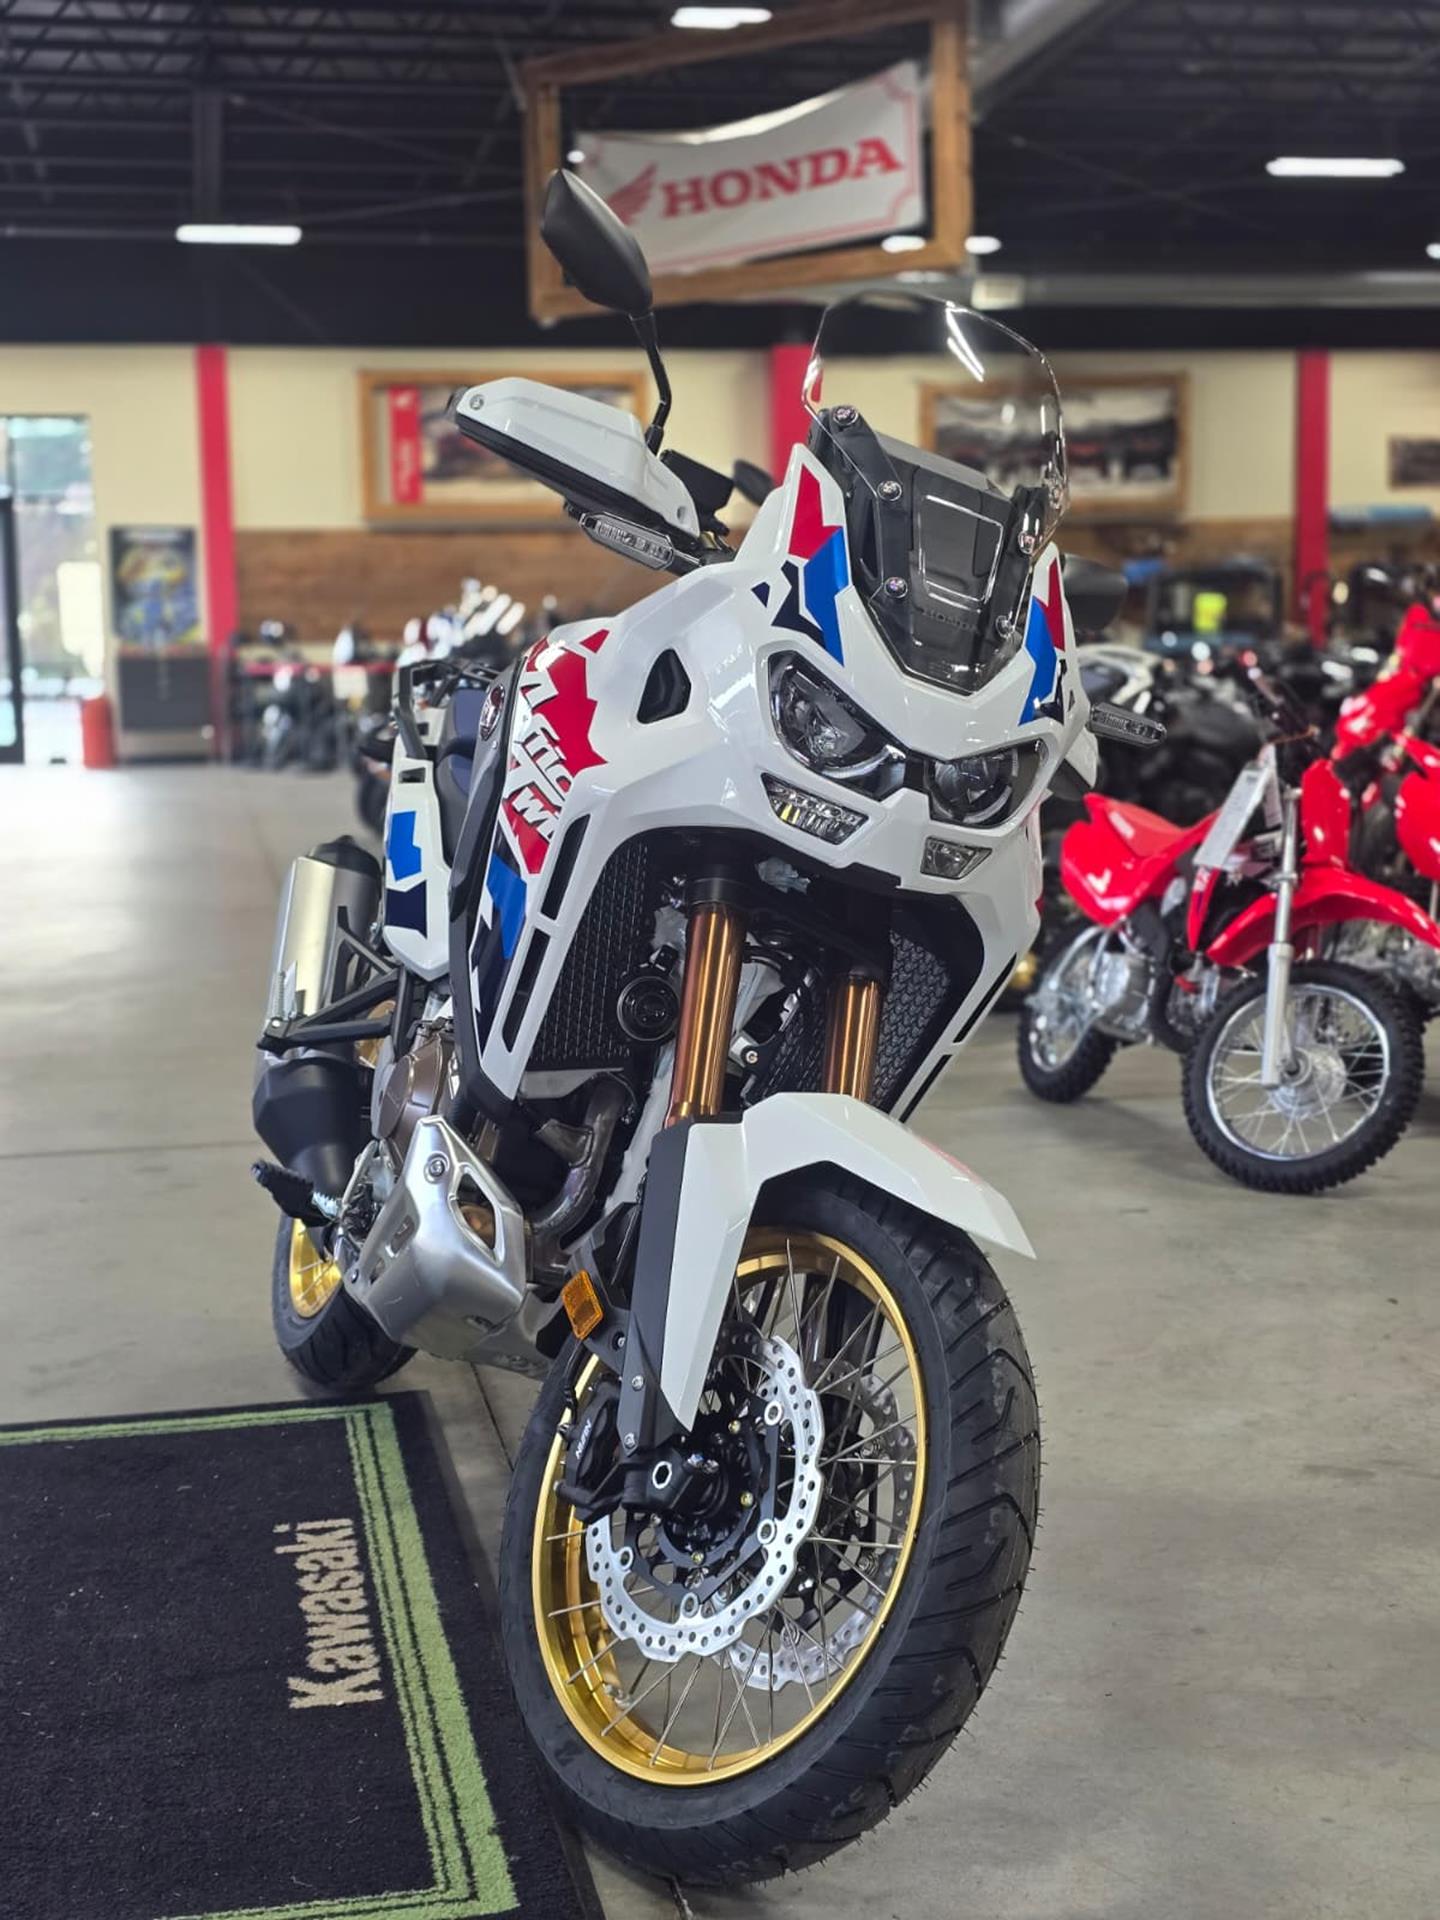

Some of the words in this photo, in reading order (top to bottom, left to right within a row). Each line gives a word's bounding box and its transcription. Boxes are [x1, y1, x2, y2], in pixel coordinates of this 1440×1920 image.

[661, 137, 902, 219] HONDA
[518, 671, 575, 796] Afric
[273, 1518, 384, 1709] Kawasaki
